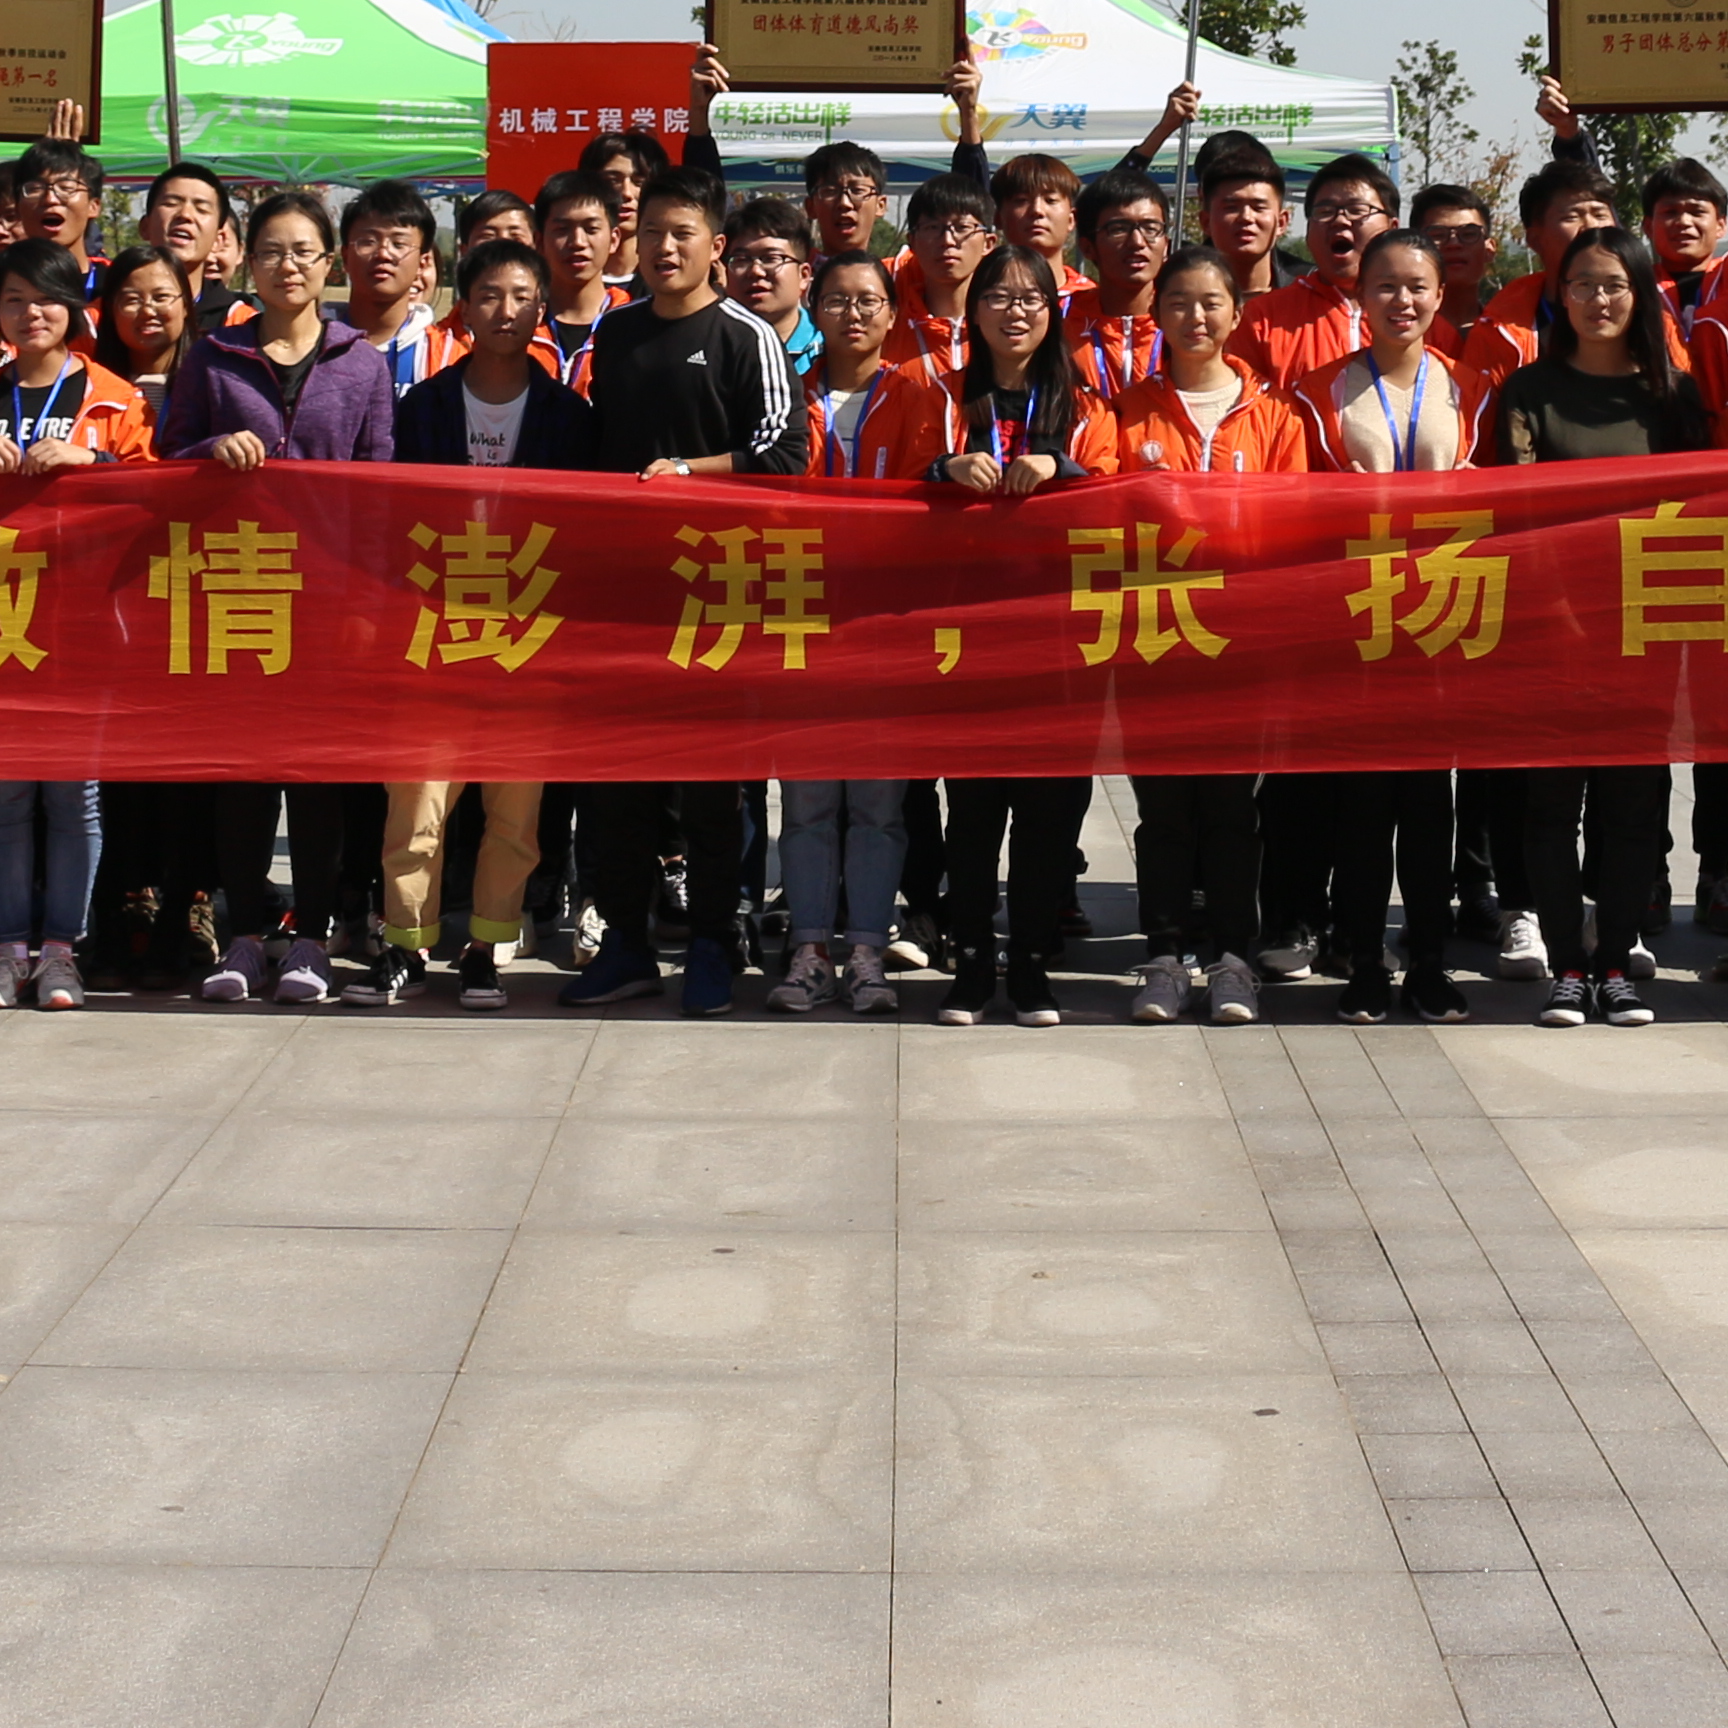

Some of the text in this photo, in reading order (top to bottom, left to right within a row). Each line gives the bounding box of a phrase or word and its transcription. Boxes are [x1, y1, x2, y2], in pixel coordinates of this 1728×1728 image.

[753, 13, 920, 36] 团体体育道德风尚奖
[499, 107, 691, 134] 机械工程学院
[1009, 103, 1089, 131] 天翼
[1198, 103, 1314, 145] 轻活出样
[470, 432, 505, 447] What
